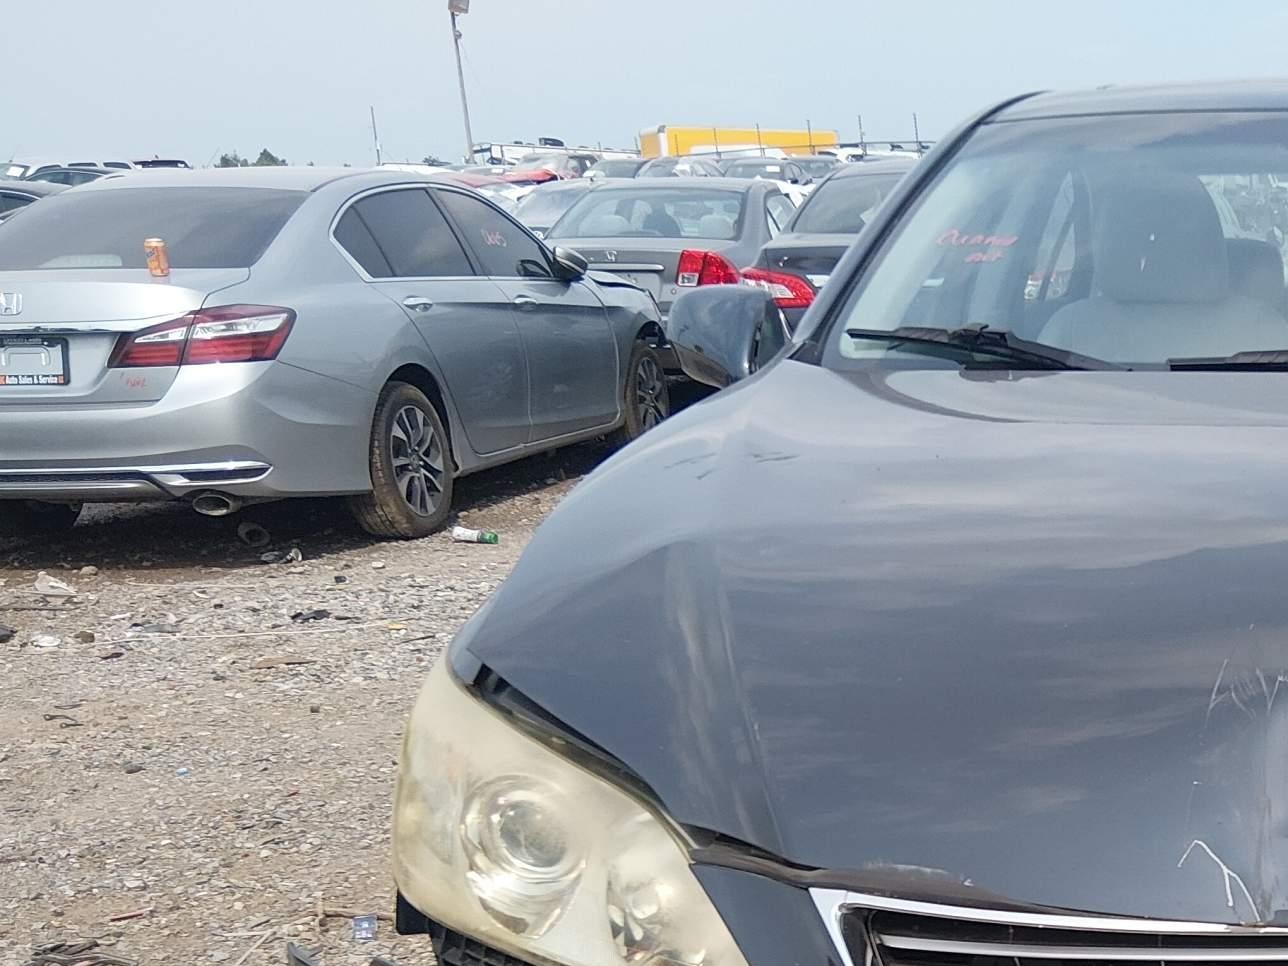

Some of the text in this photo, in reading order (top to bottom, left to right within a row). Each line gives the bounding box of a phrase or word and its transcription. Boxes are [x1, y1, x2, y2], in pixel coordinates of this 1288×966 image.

[6, 375, 18, 384] Auto
[19, 375, 33, 384] Sales
[39, 375, 58, 384] Service
